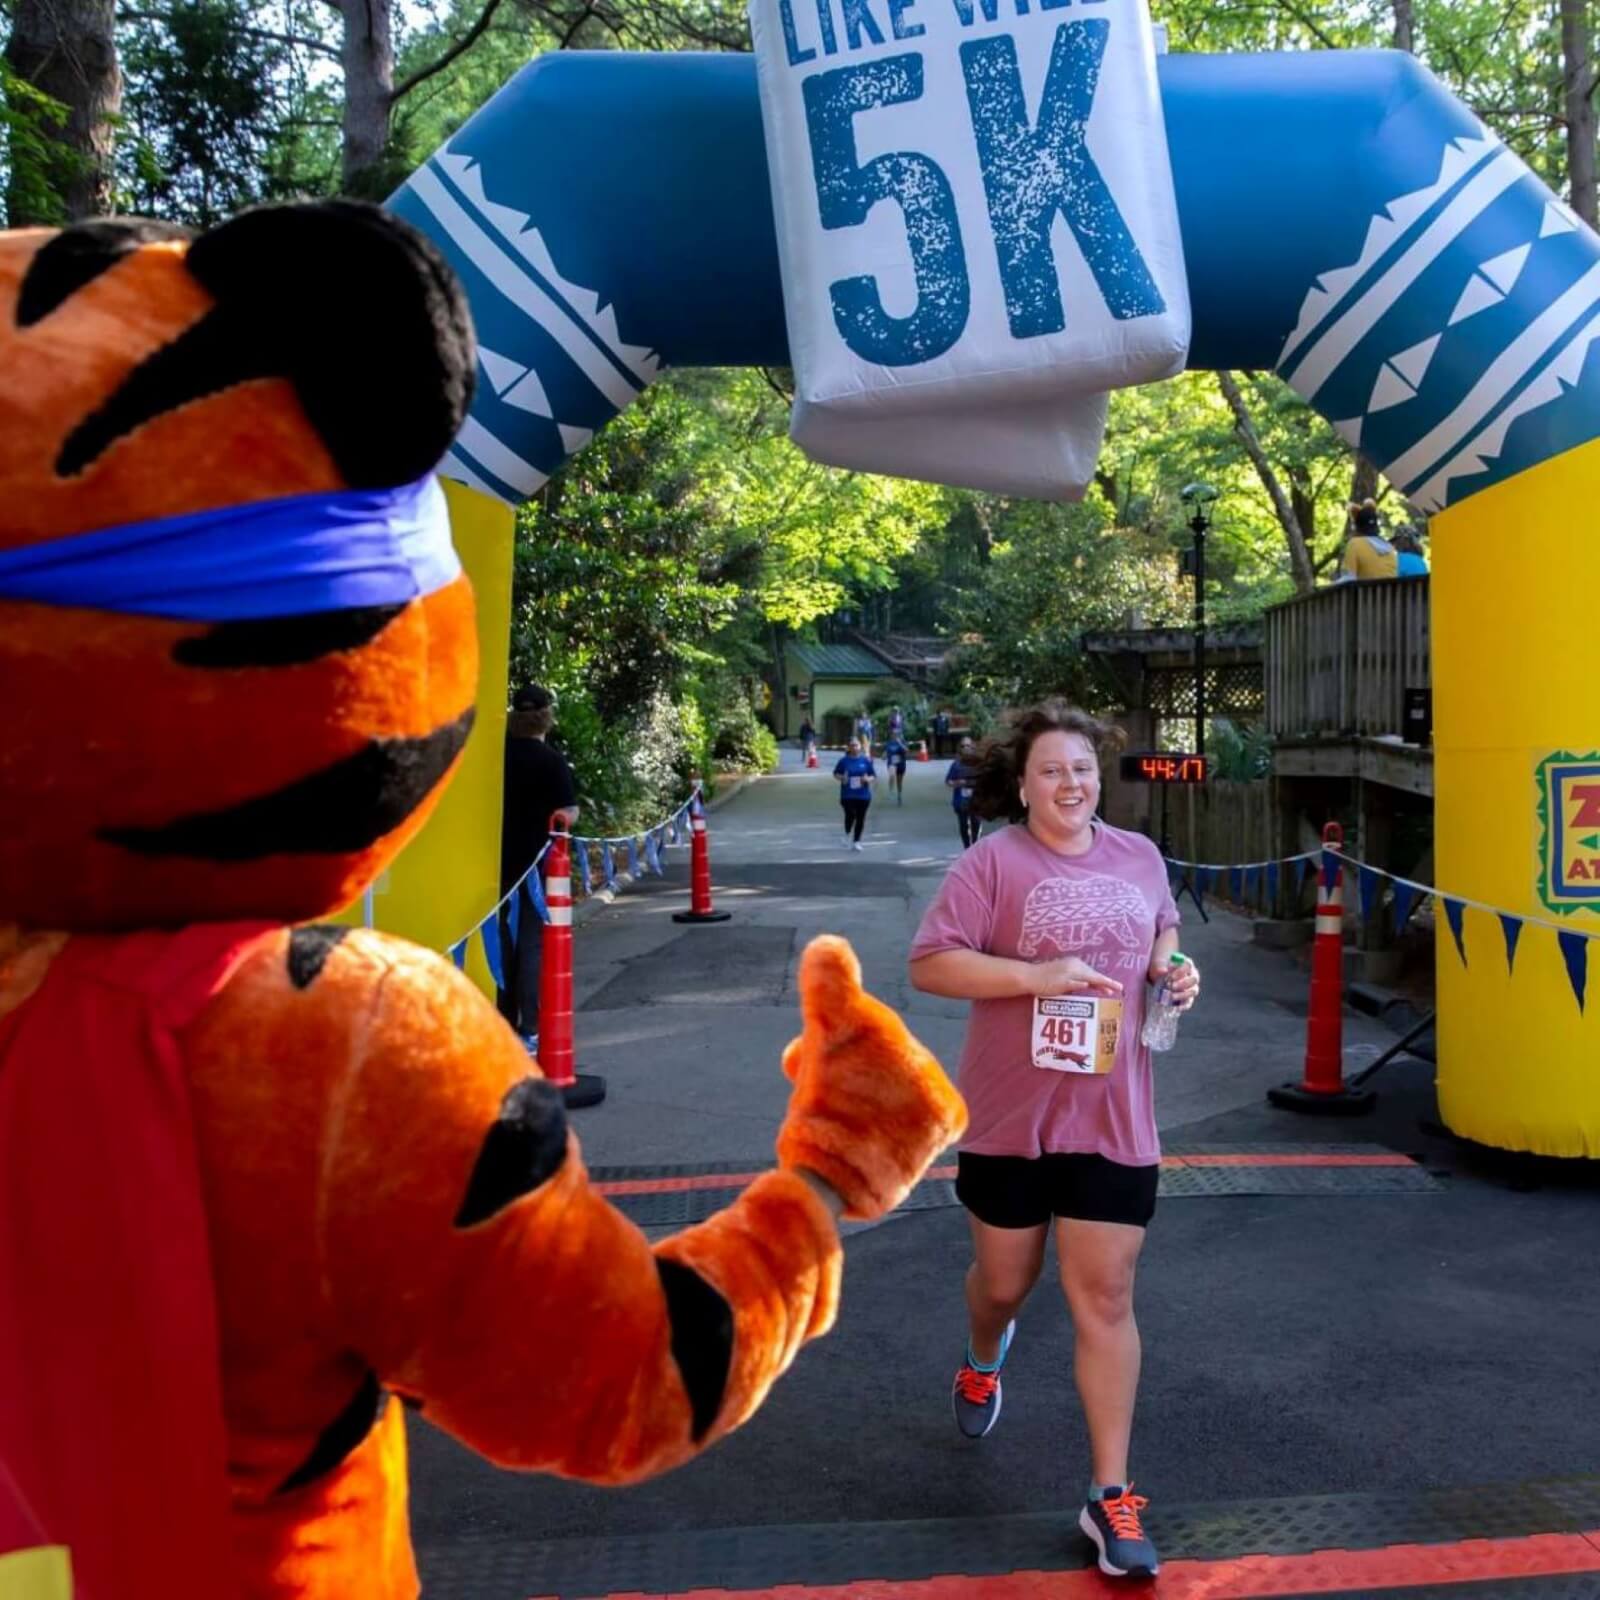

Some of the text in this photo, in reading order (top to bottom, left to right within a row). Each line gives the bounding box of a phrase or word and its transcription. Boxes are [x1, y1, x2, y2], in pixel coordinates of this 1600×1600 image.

[802, 18, 1166, 366] 5K
[1143, 759, 1202, 779] 44:17
[1041, 1018, 1087, 1047] 461
